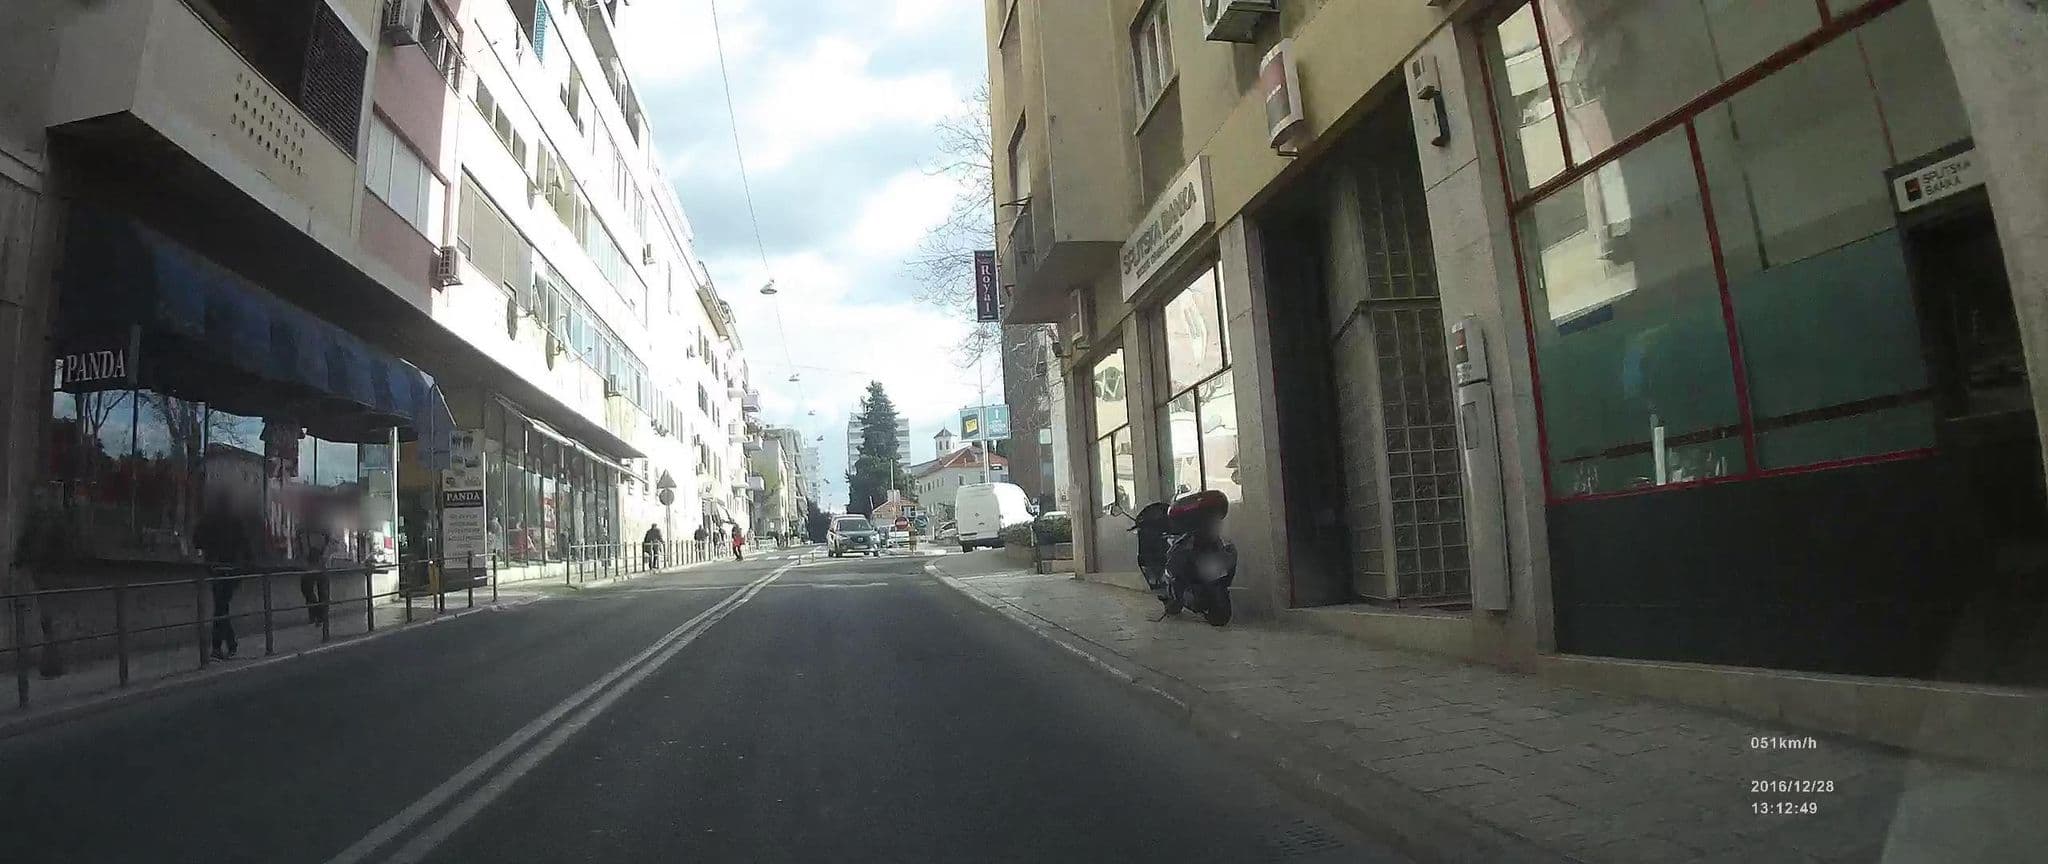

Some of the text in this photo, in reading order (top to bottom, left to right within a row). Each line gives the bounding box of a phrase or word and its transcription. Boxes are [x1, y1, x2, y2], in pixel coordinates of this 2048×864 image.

[981, 264, 992, 313] Royal
[65, 348, 126, 383] PANDA
[446, 491, 481, 502] PANDA
